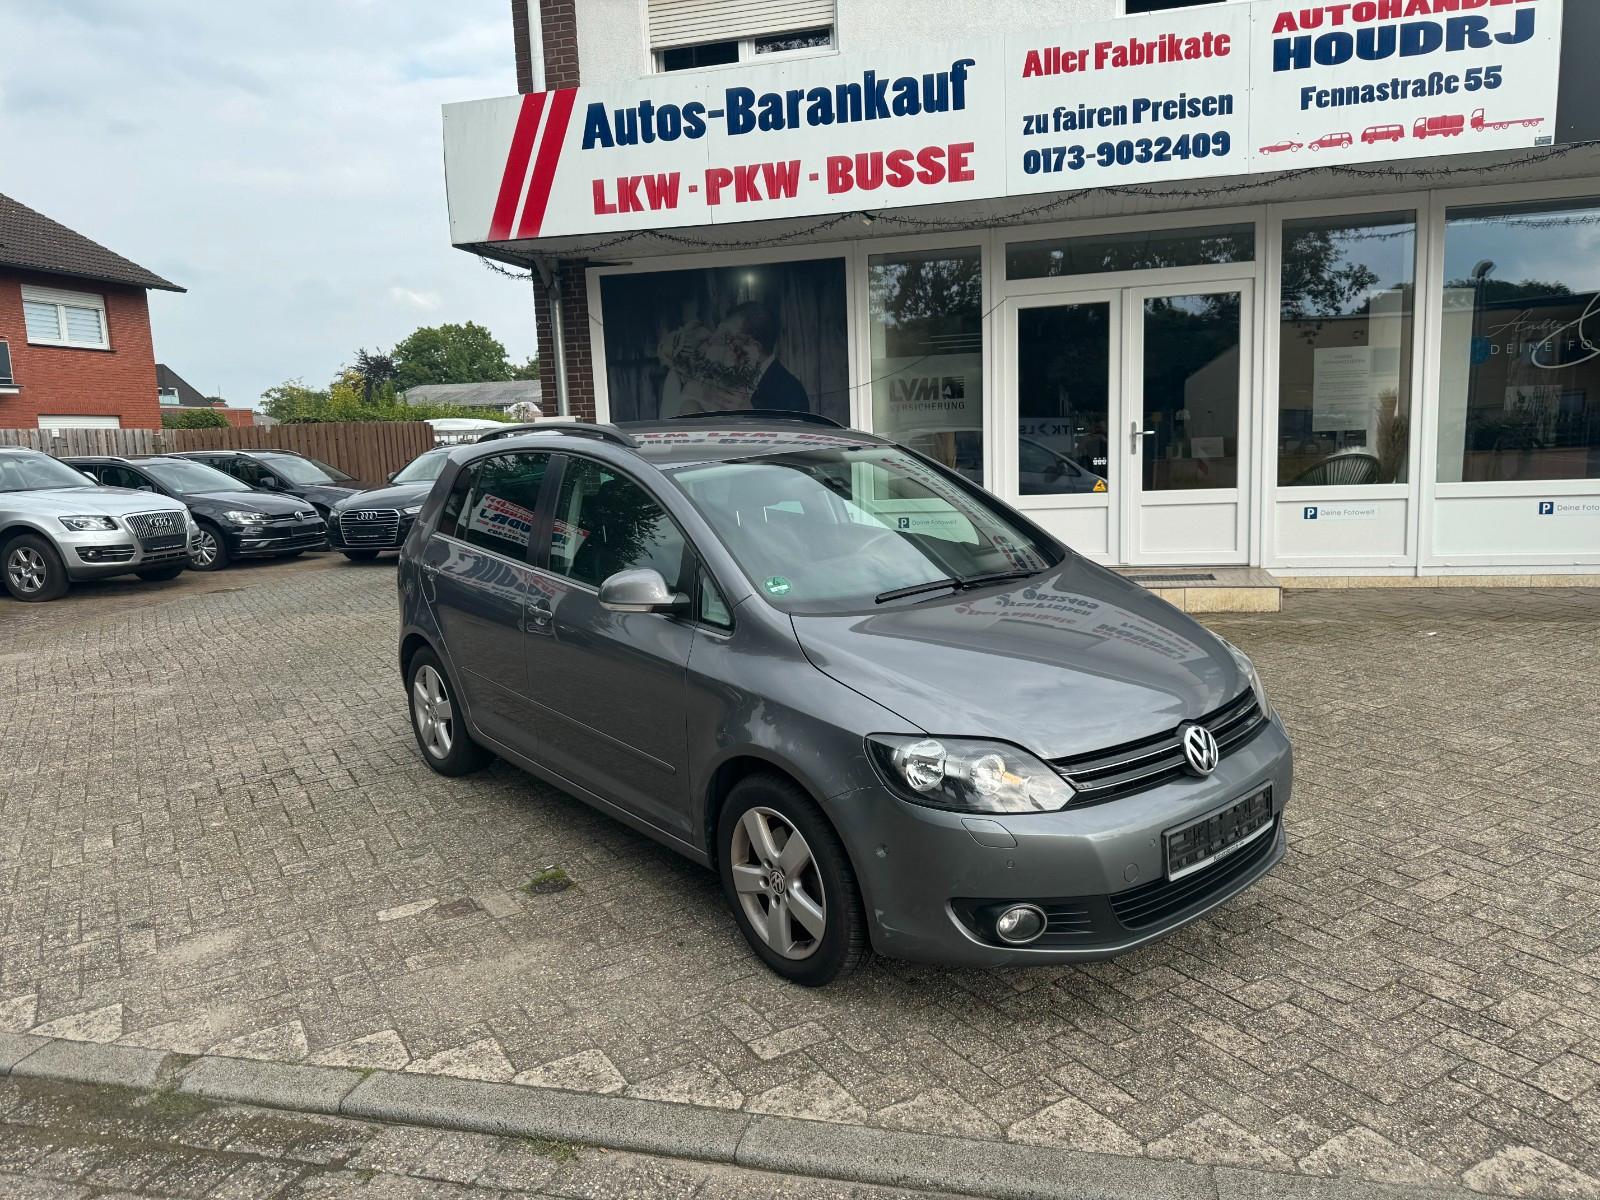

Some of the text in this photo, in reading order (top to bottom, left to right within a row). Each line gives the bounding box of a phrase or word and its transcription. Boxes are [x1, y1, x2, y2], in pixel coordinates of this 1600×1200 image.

[1273, 0, 1534, 33] AUTOHAN
[1023, 32, 1231, 78] Aller Fabrikate
[1273, 8, 1535, 72] HOUDRJ
[581, 58, 976, 150] Autos-Barankauf
[1300, 65, 1503, 111] Fennastraße 55
[1023, 94, 1233, 136] zu fairen Preisen
[1023, 131, 1231, 175] 0173-9032409
[592, 172, 680, 215] LKW
[704, 160, 801, 206] PKW
[826, 143, 975, 195] BUSSE
[1490, 341, 1552, 355] DEINE
[889, 376, 940, 402] LVM
[889, 401, 966, 413] RSICHERUNG
[1320, 509, 1342, 517] Deine
